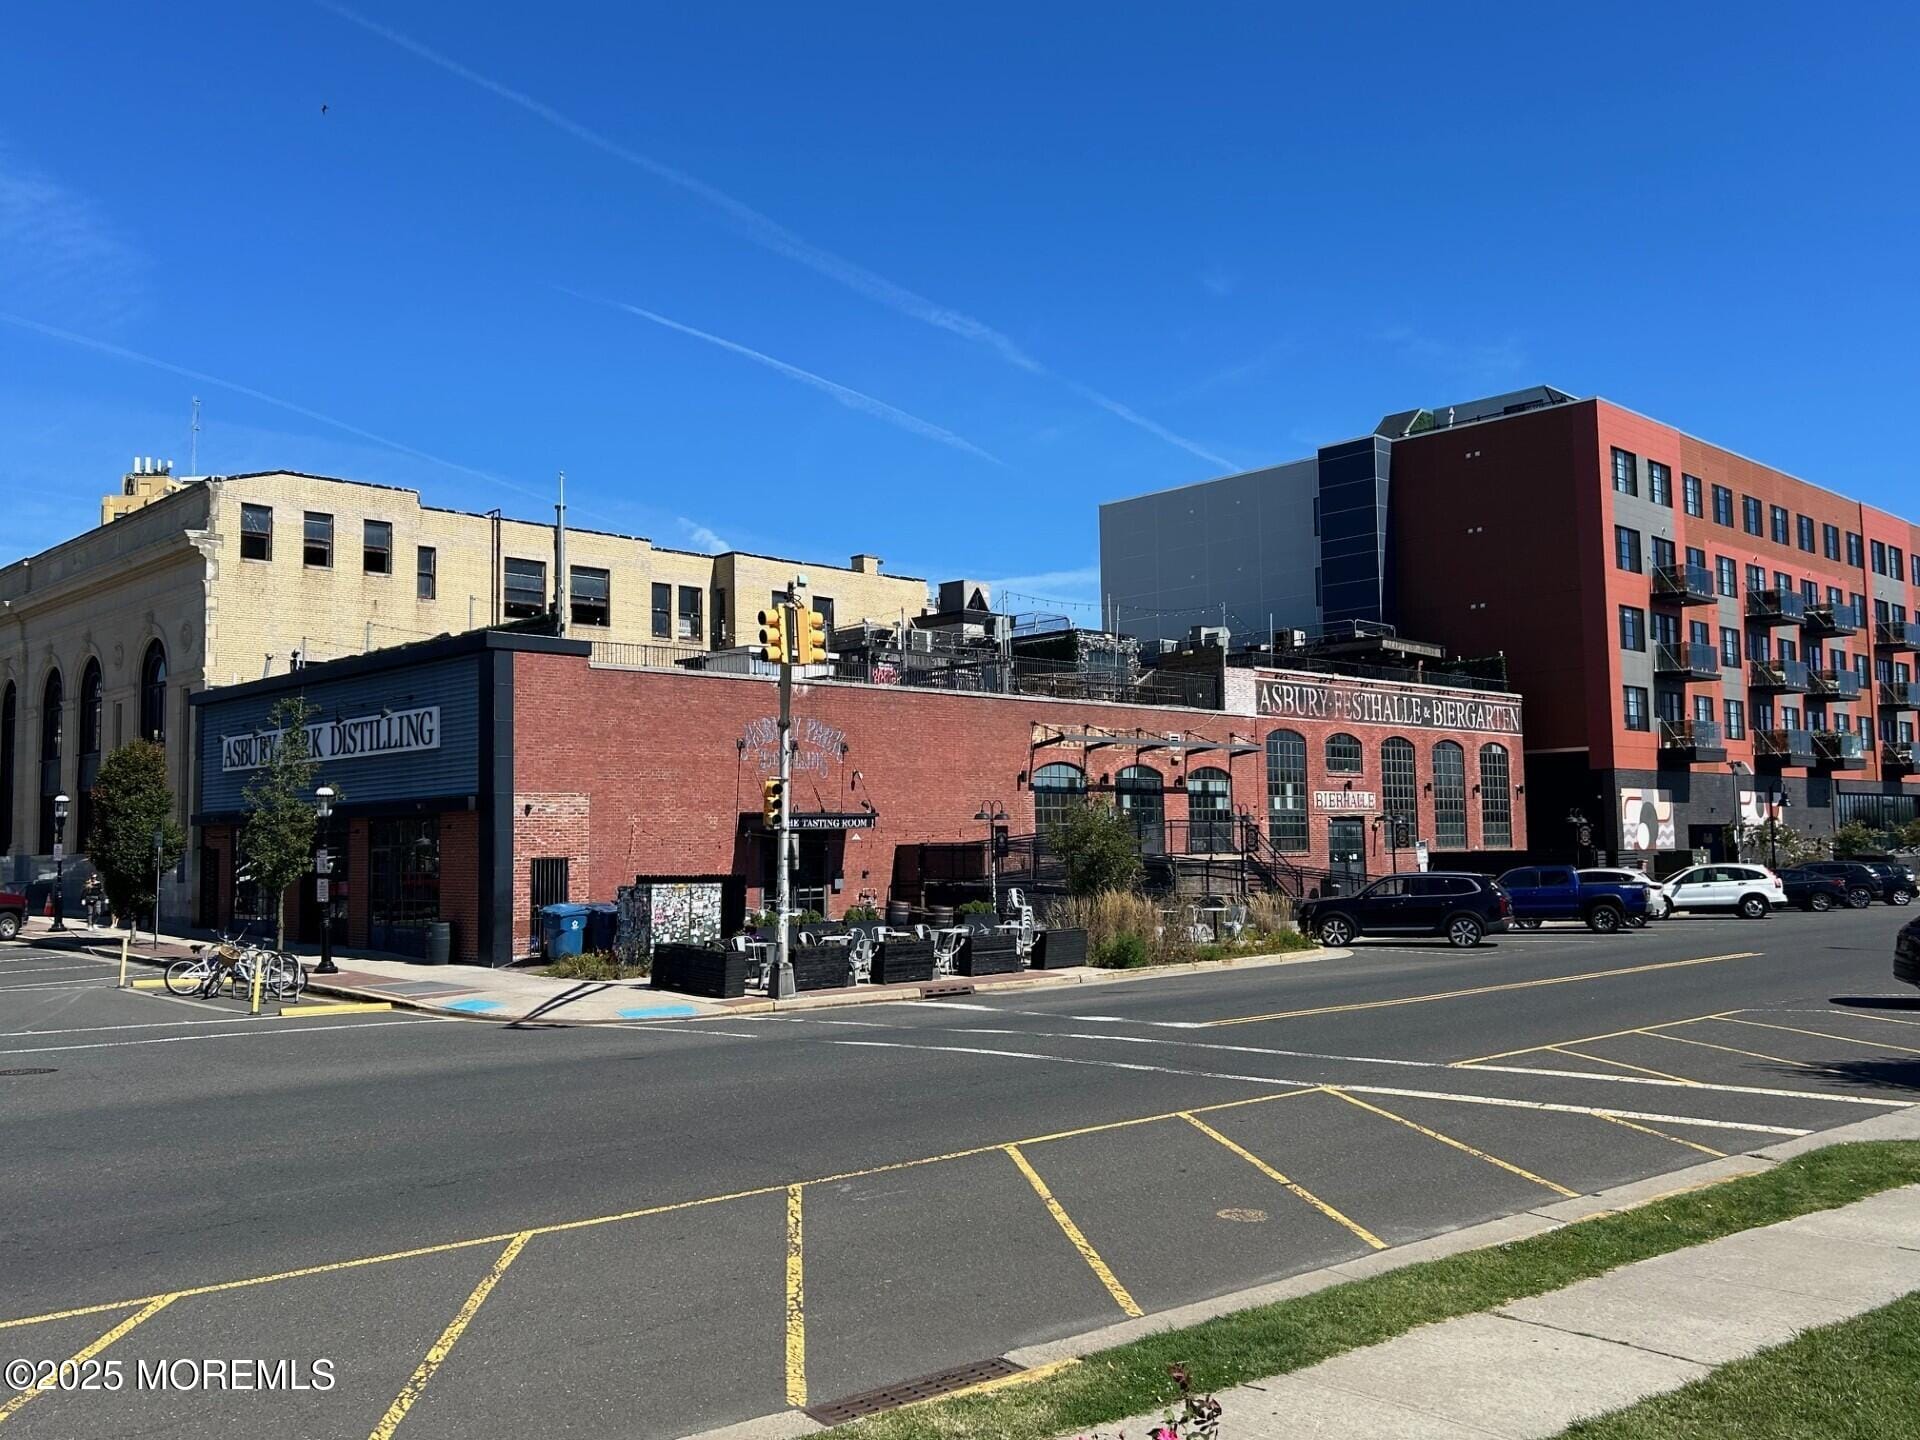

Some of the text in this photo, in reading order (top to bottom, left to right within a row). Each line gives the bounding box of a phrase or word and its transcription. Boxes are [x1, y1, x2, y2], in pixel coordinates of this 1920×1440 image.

[1257, 683, 1520, 731] ASBURY FESTHALLE & BIERGARTEN
[330, 711, 434, 756] DISTILLING
[1315, 792, 1375, 808] BIERHALLE
[802, 818, 839, 828] TASTING
[842, 818, 867, 827] ROOM
